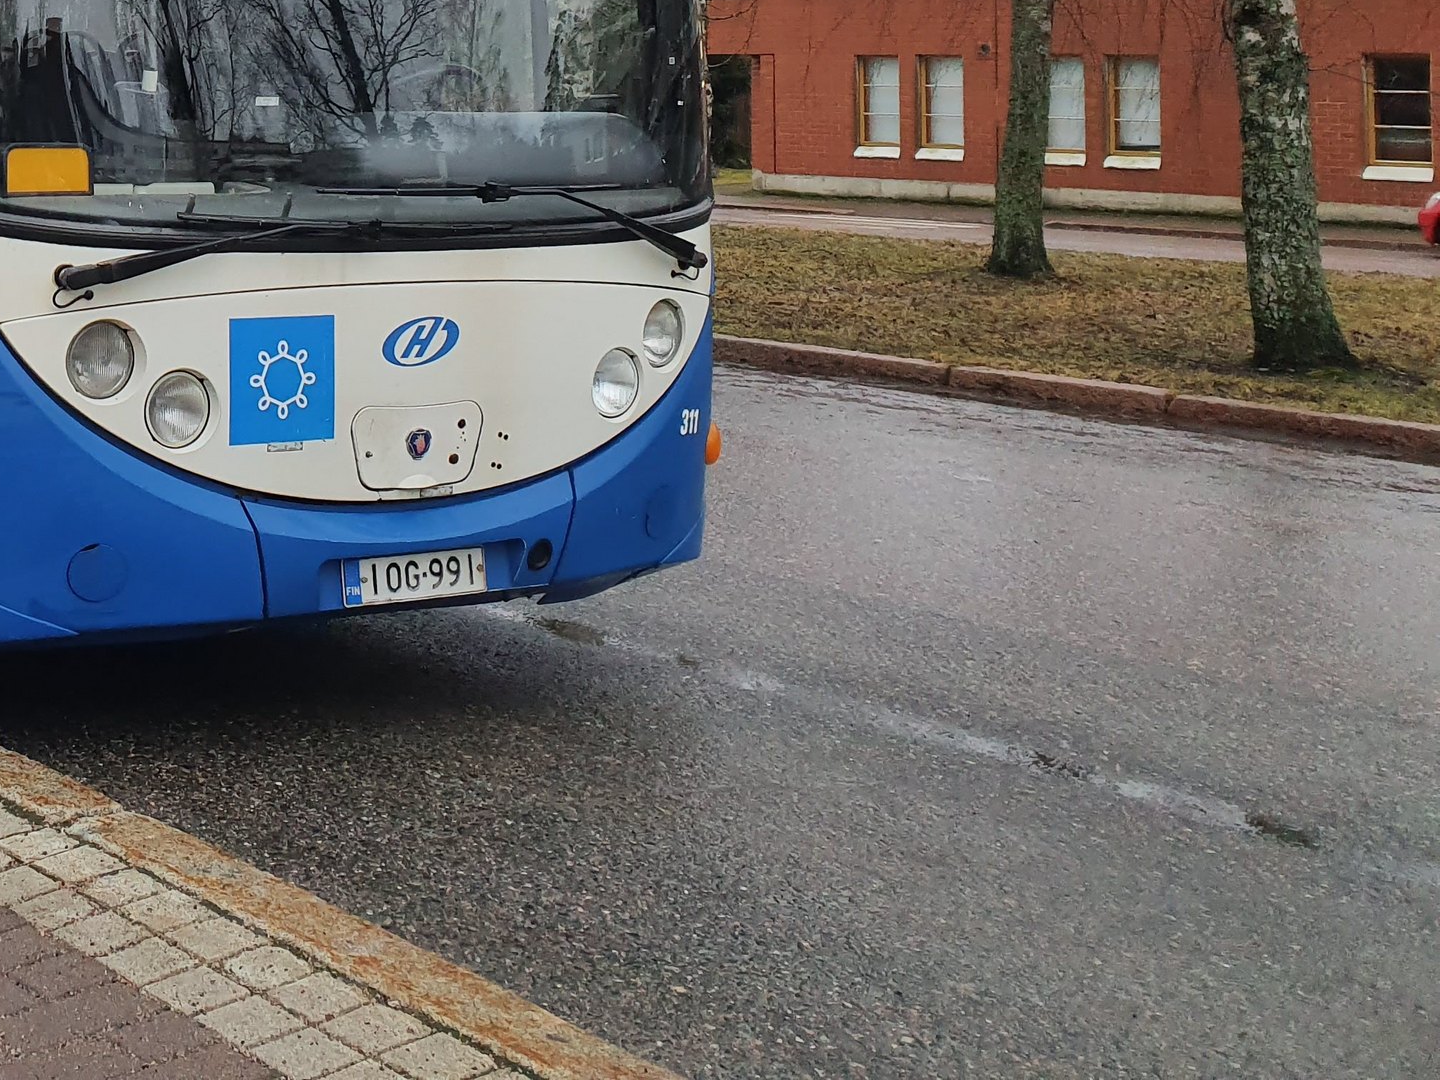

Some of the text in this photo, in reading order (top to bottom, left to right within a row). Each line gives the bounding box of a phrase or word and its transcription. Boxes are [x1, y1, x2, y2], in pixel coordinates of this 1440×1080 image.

[680, 408, 700, 436] 311
[371, 553, 475, 596] IOG-991
[345, 586, 361, 597] FIN
